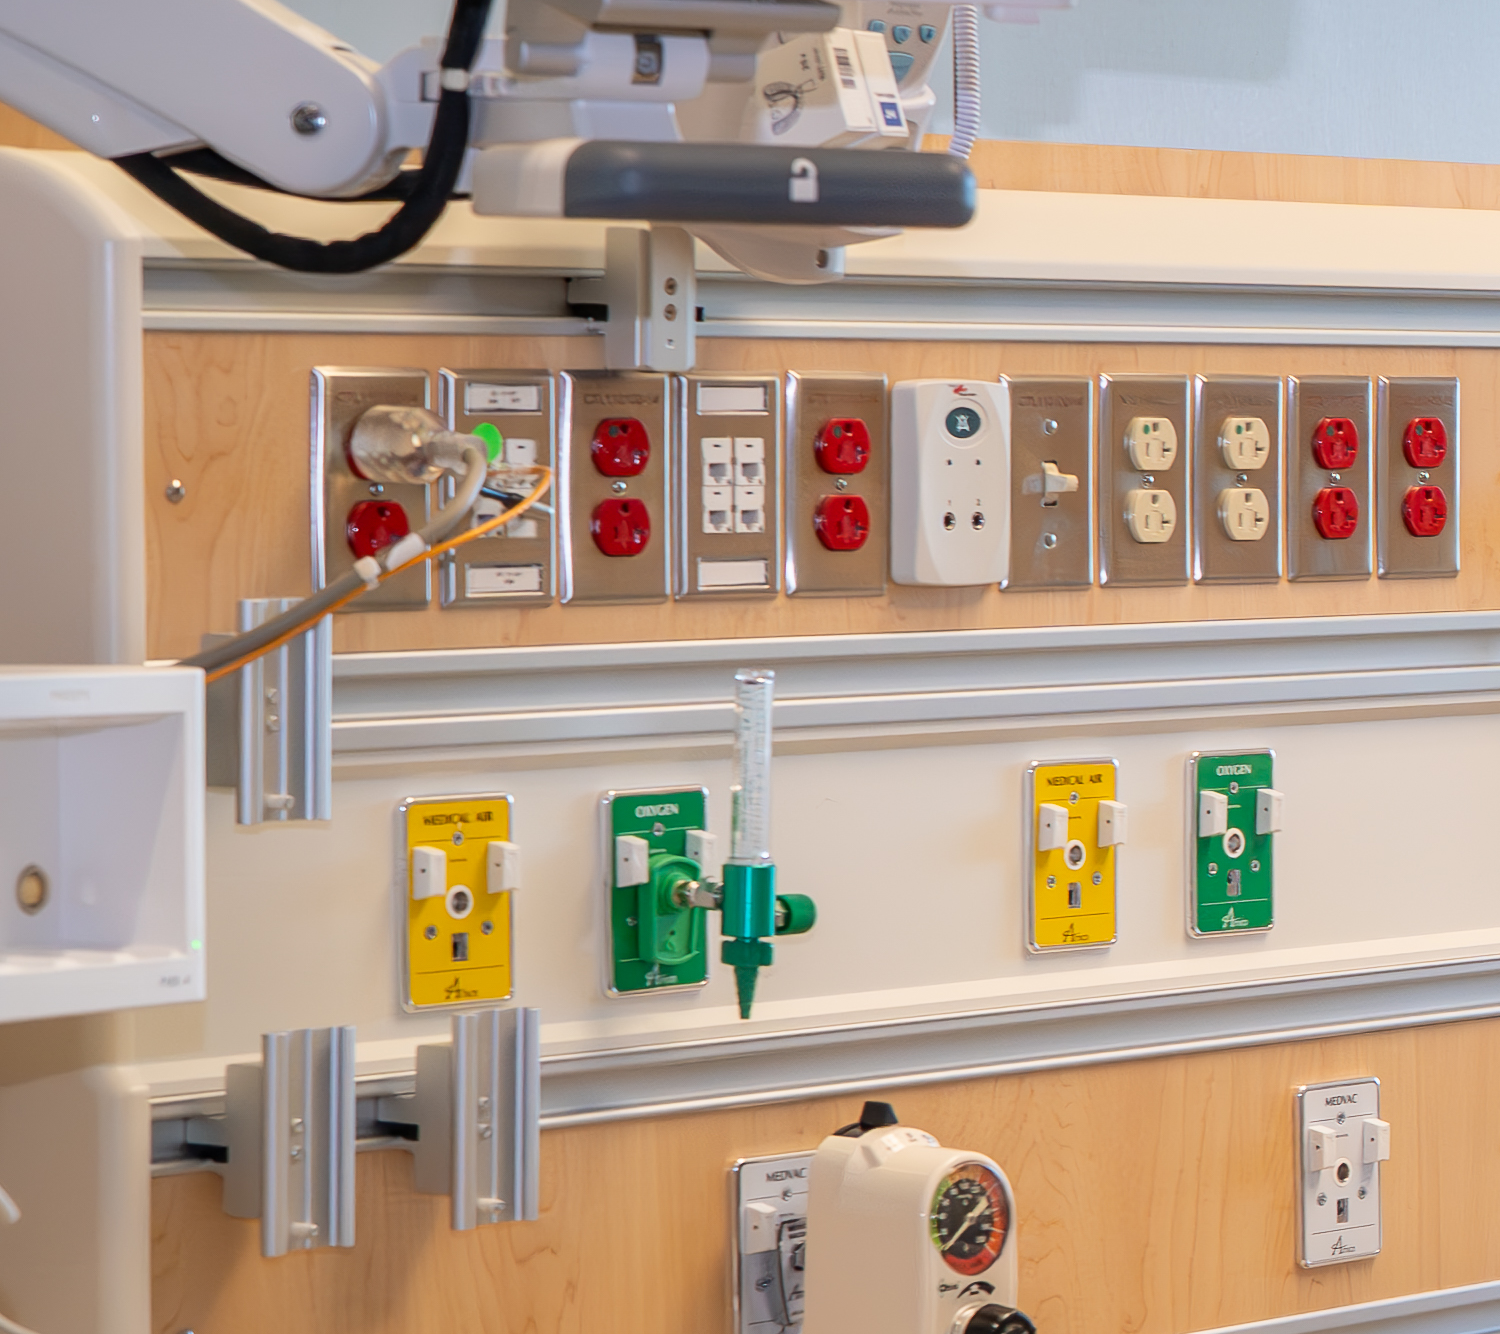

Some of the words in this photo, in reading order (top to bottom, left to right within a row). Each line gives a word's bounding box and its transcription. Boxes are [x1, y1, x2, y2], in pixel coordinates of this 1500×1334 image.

[1216, 764, 1252, 776] OXYGEN
[1046, 775, 1084, 787] MEDICAL
[1089, 774, 1103, 784] AIR
[635, 803, 679, 818] OXYGEN
[1325, 1094, 1358, 1106] MEDVAC
